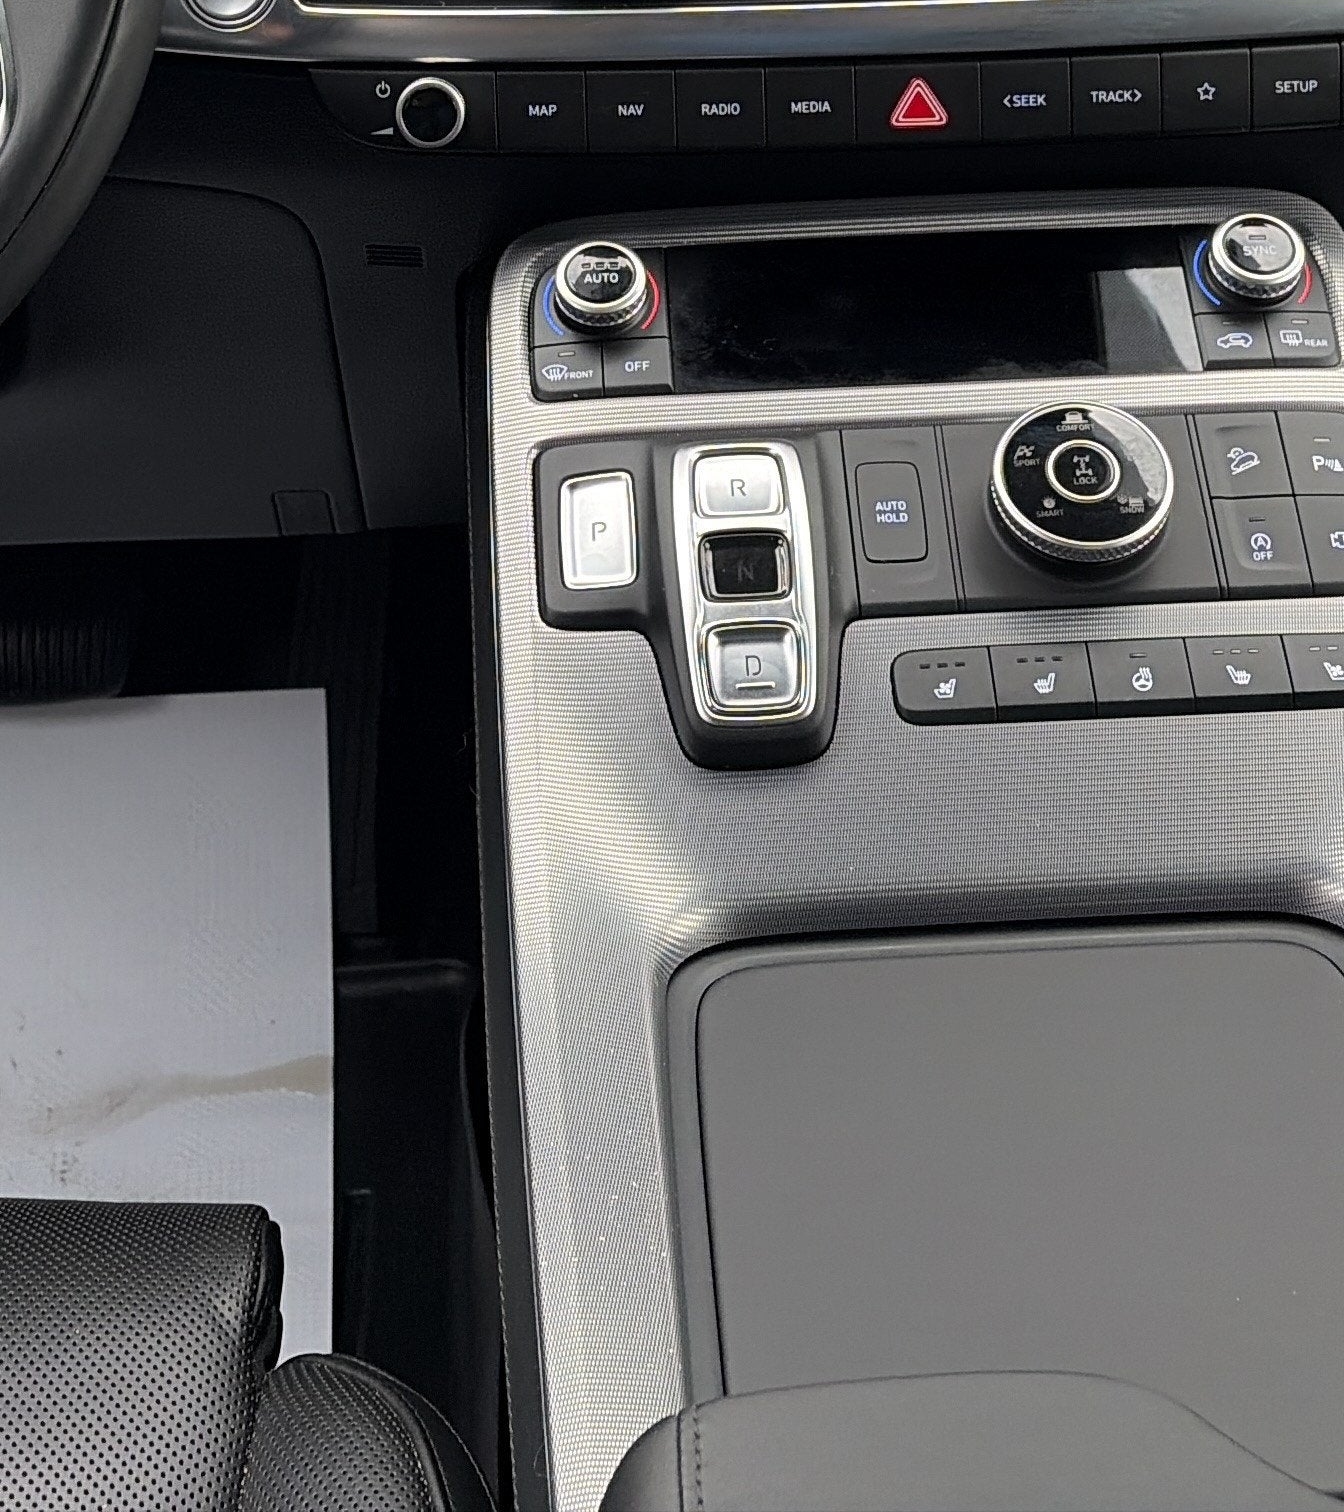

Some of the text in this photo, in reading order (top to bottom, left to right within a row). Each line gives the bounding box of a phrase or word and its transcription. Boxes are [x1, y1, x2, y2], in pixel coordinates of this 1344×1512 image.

[1274, 79, 1318, 94] SETUP
[528, 104, 558, 117] MAP
[617, 104, 644, 117] NAV
[700, 102, 741, 116] RADIO
[790, 100, 831, 114] MEDIA
[1242, 244, 1278, 257] SYNC
[583, 272, 619, 285] AUTO
[1304, 337, 1329, 348] REAR
[624, 359, 650, 373] OFF
[564, 369, 594, 380] FRONT
[1013, 458, 1041, 467] SPORT
[1073, 476, 1099, 486] LOCK
[729, 478, 746, 498] R
[875, 499, 907, 512] AUTO
[1119, 505, 1145, 515] SNOW
[876, 511, 909, 524] HOLD
[1035, 508, 1065, 519] SMART
[590, 520, 608, 543] P
[1252, 549, 1274, 562] OFF
[737, 562, 756, 583] N
[744, 654, 763, 677] D
